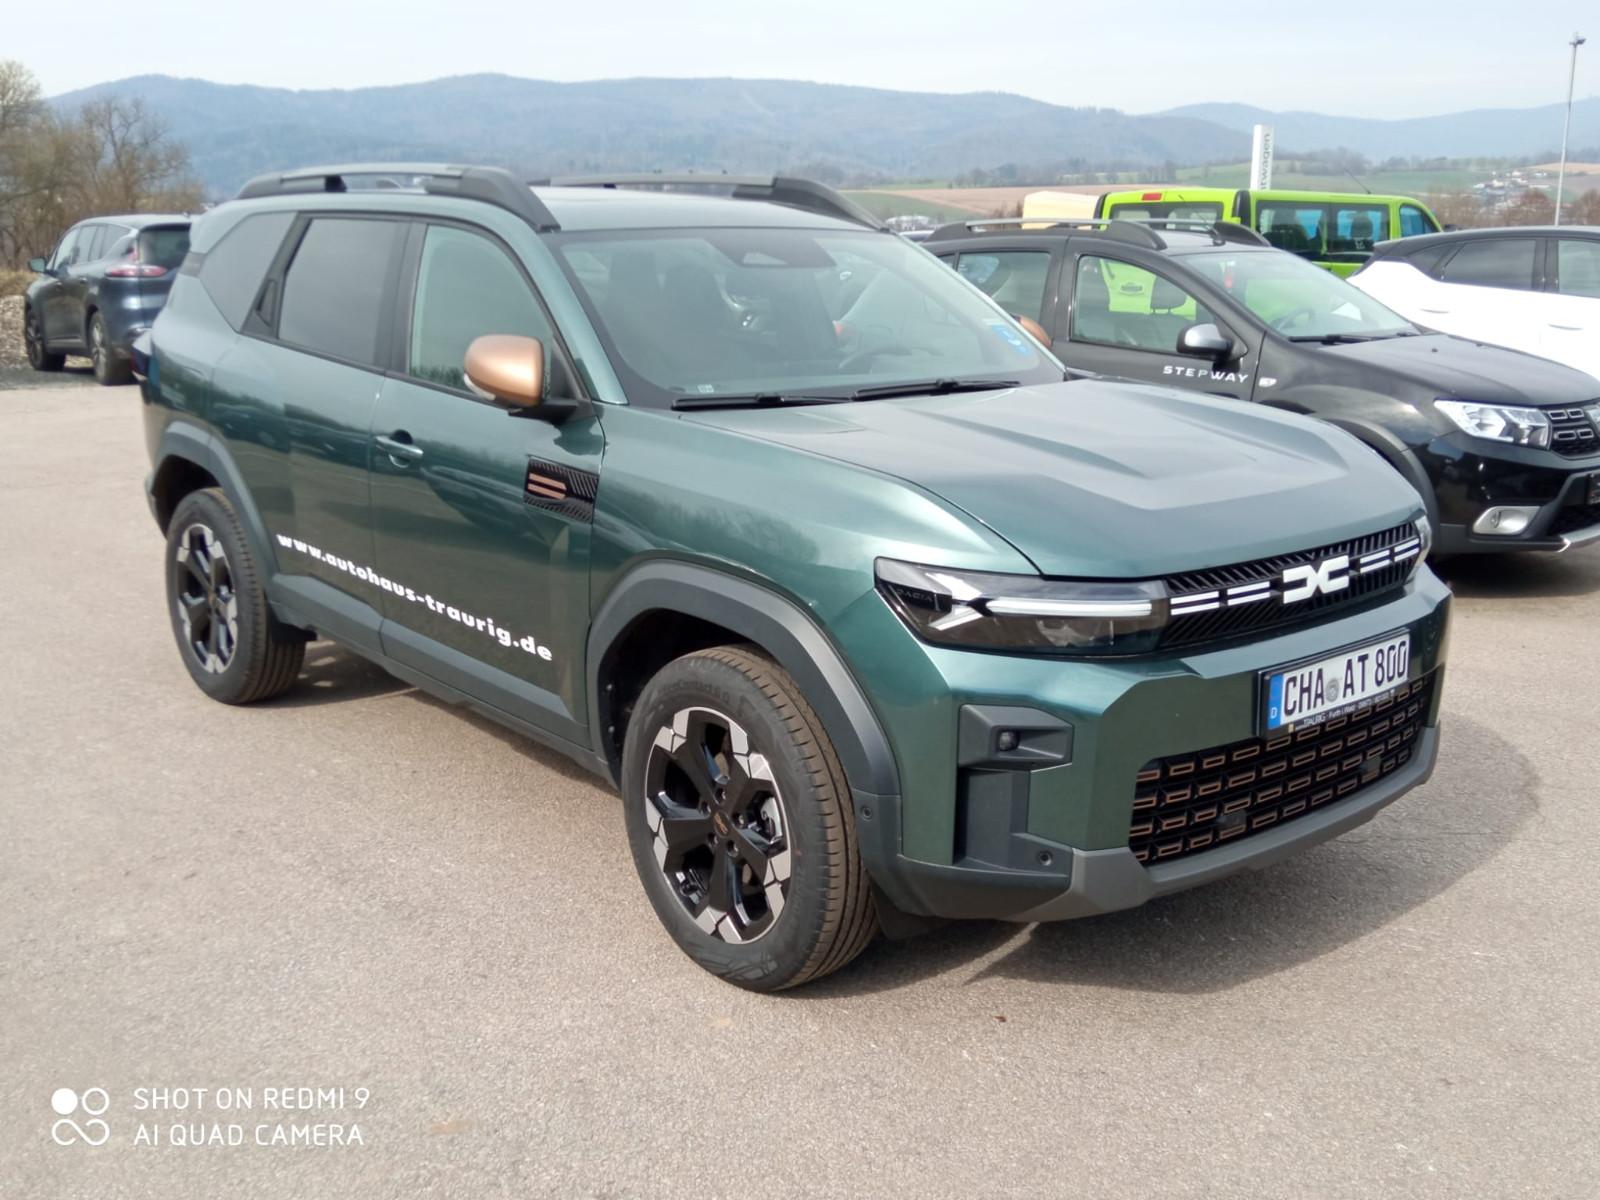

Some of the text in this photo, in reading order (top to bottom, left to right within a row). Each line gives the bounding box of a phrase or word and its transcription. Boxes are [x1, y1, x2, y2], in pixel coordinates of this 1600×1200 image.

[1163, 365, 1248, 383] STEPWAY
[276, 533, 553, 661] www.autohaus-traurig.de
[1284, 668, 1325, 716] CHA
[1343, 654, 1369, 698] AT
[1374, 640, 1406, 687] 800
